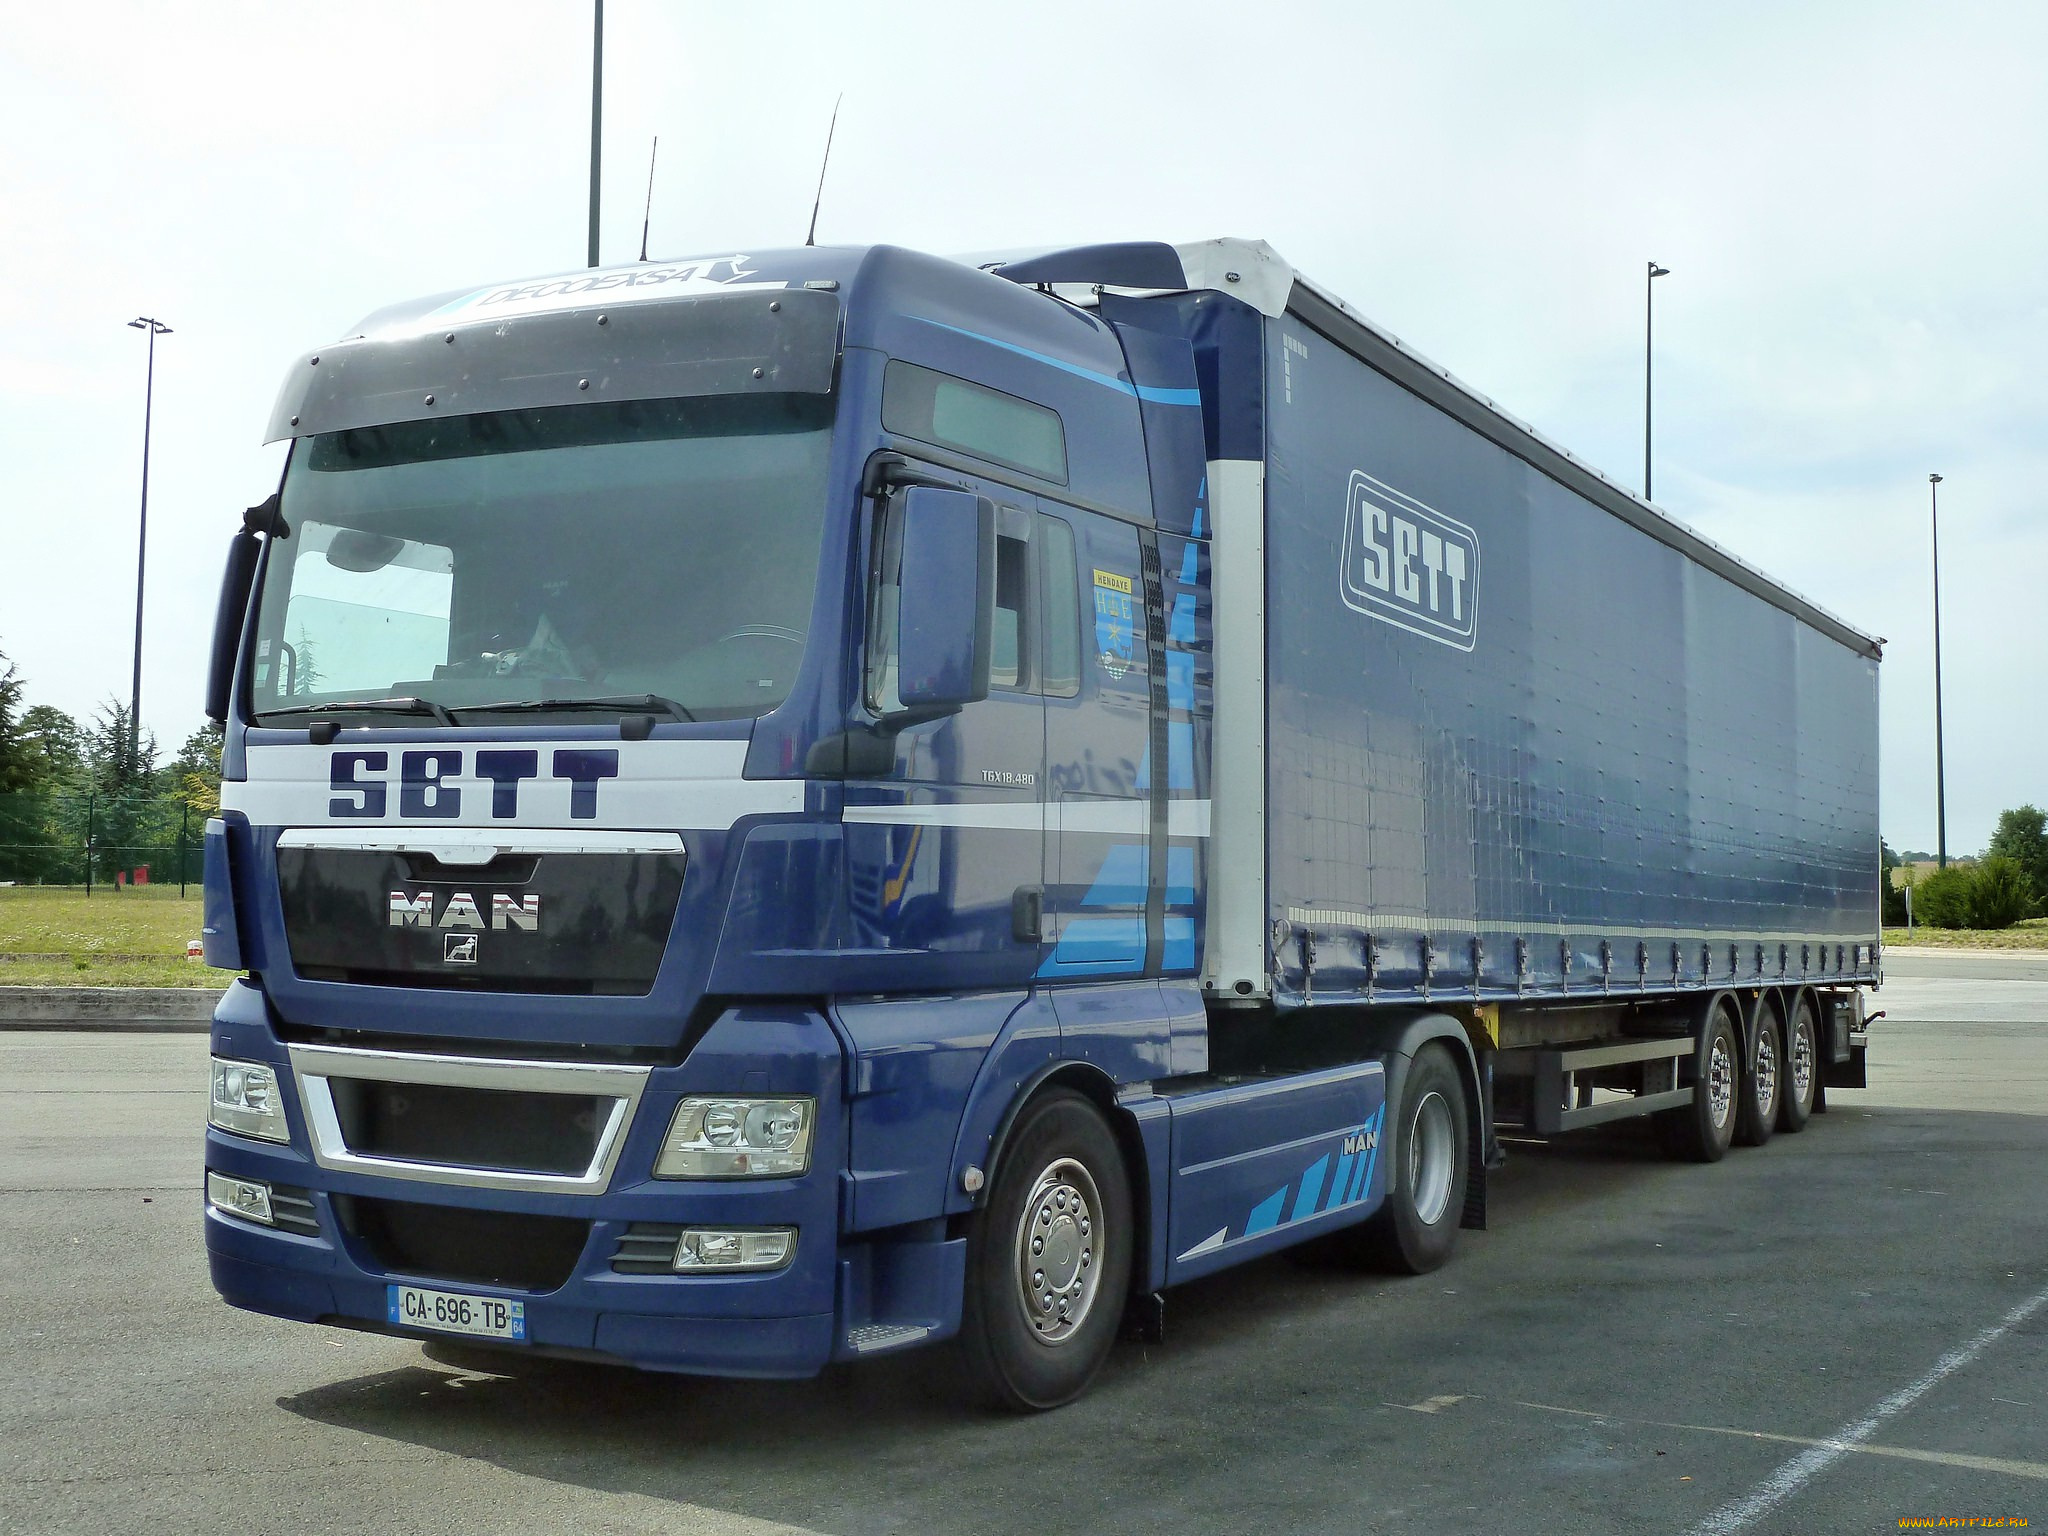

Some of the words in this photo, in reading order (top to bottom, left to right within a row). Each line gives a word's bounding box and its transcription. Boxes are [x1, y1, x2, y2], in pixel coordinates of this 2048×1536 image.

[478, 266, 698, 307] DECOEXSA
[1097, 573, 1129, 591] HENDAYE
[389, 891, 540, 931] MAN
[1343, 1131, 1377, 1156] MAN
[405, 1291, 507, 1329] CA-696-TB
[513, 1321, 524, 1334] 64
